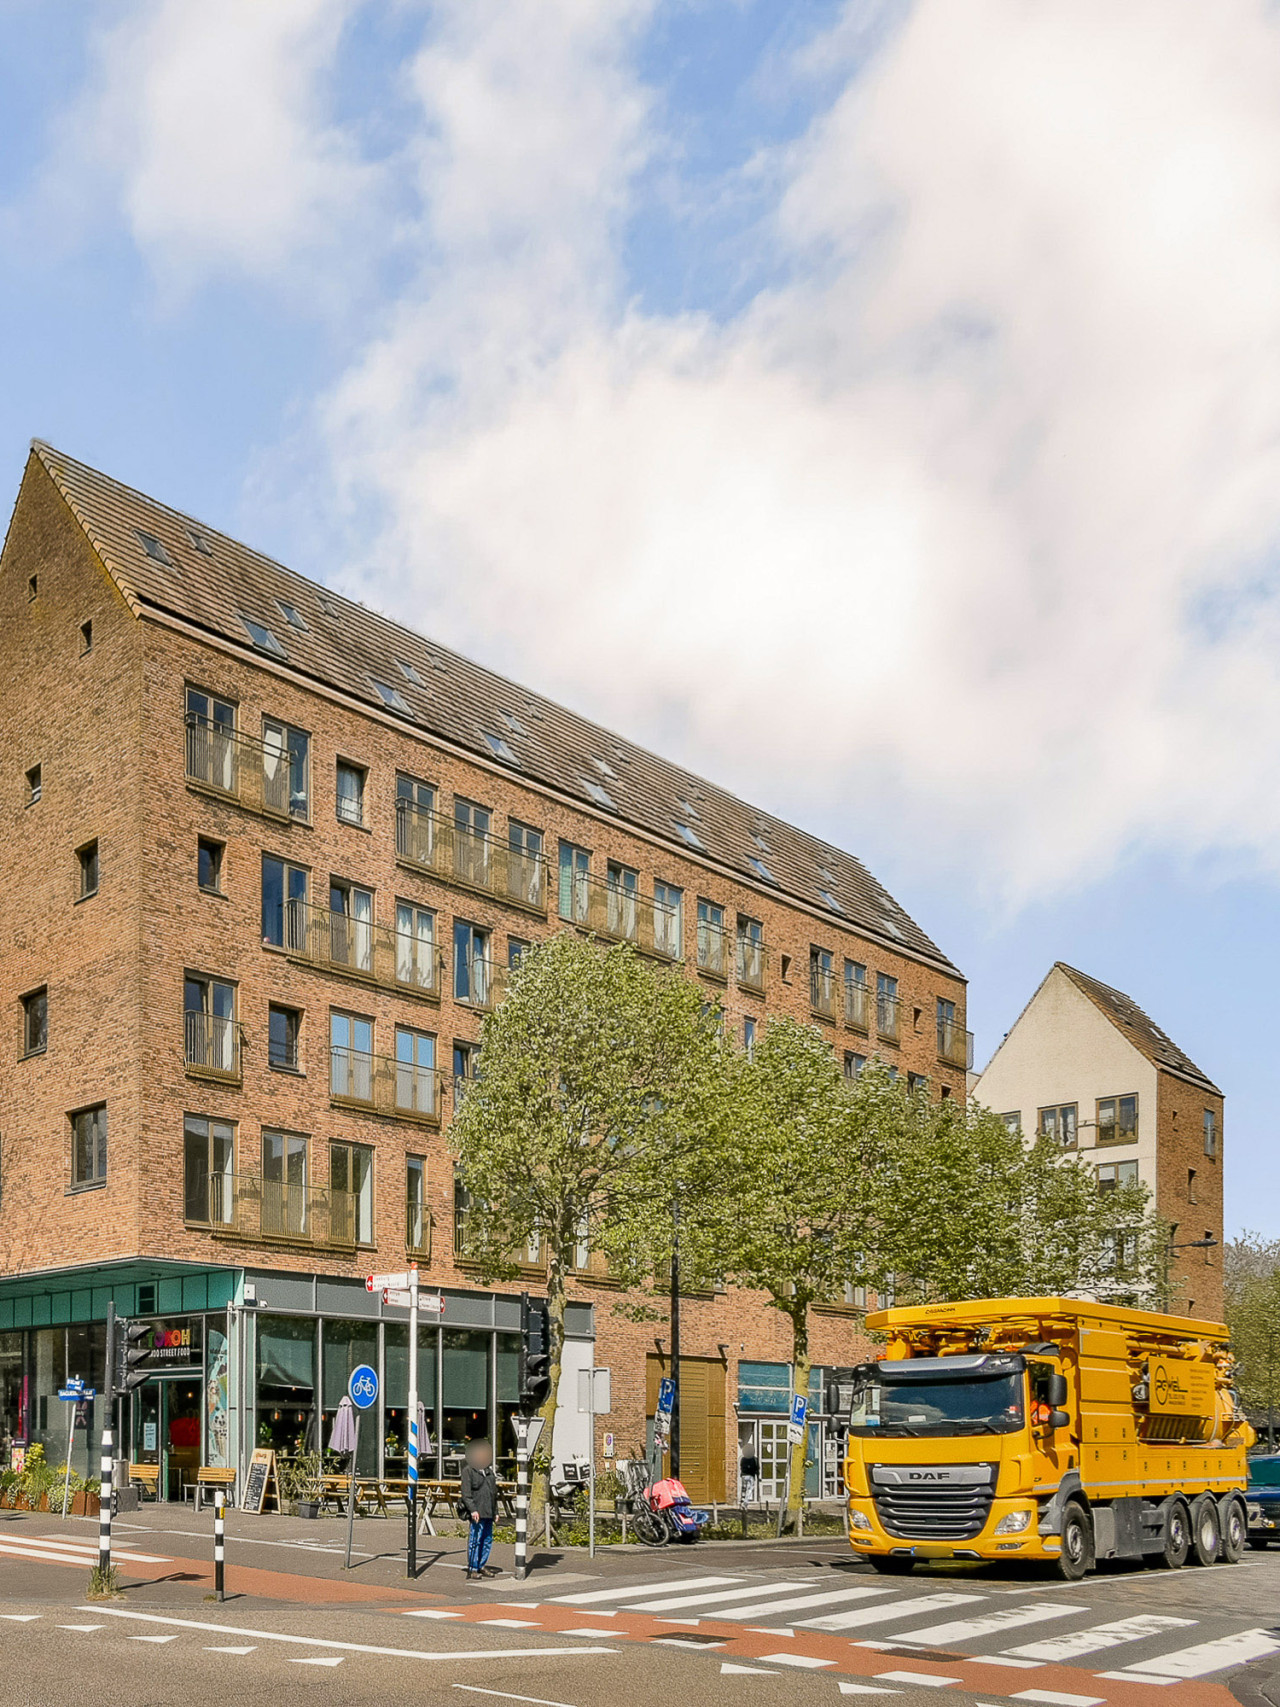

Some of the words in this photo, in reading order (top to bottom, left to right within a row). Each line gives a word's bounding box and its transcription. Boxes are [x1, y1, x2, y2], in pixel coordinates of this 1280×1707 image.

[146, 1328, 191, 1348] TOKOH
[160, 1348, 177, 1358] STREET
[177, 1346, 191, 1357] FOOD
[795, 1396, 805, 1412] P
[909, 1472, 950, 1480] DAF
